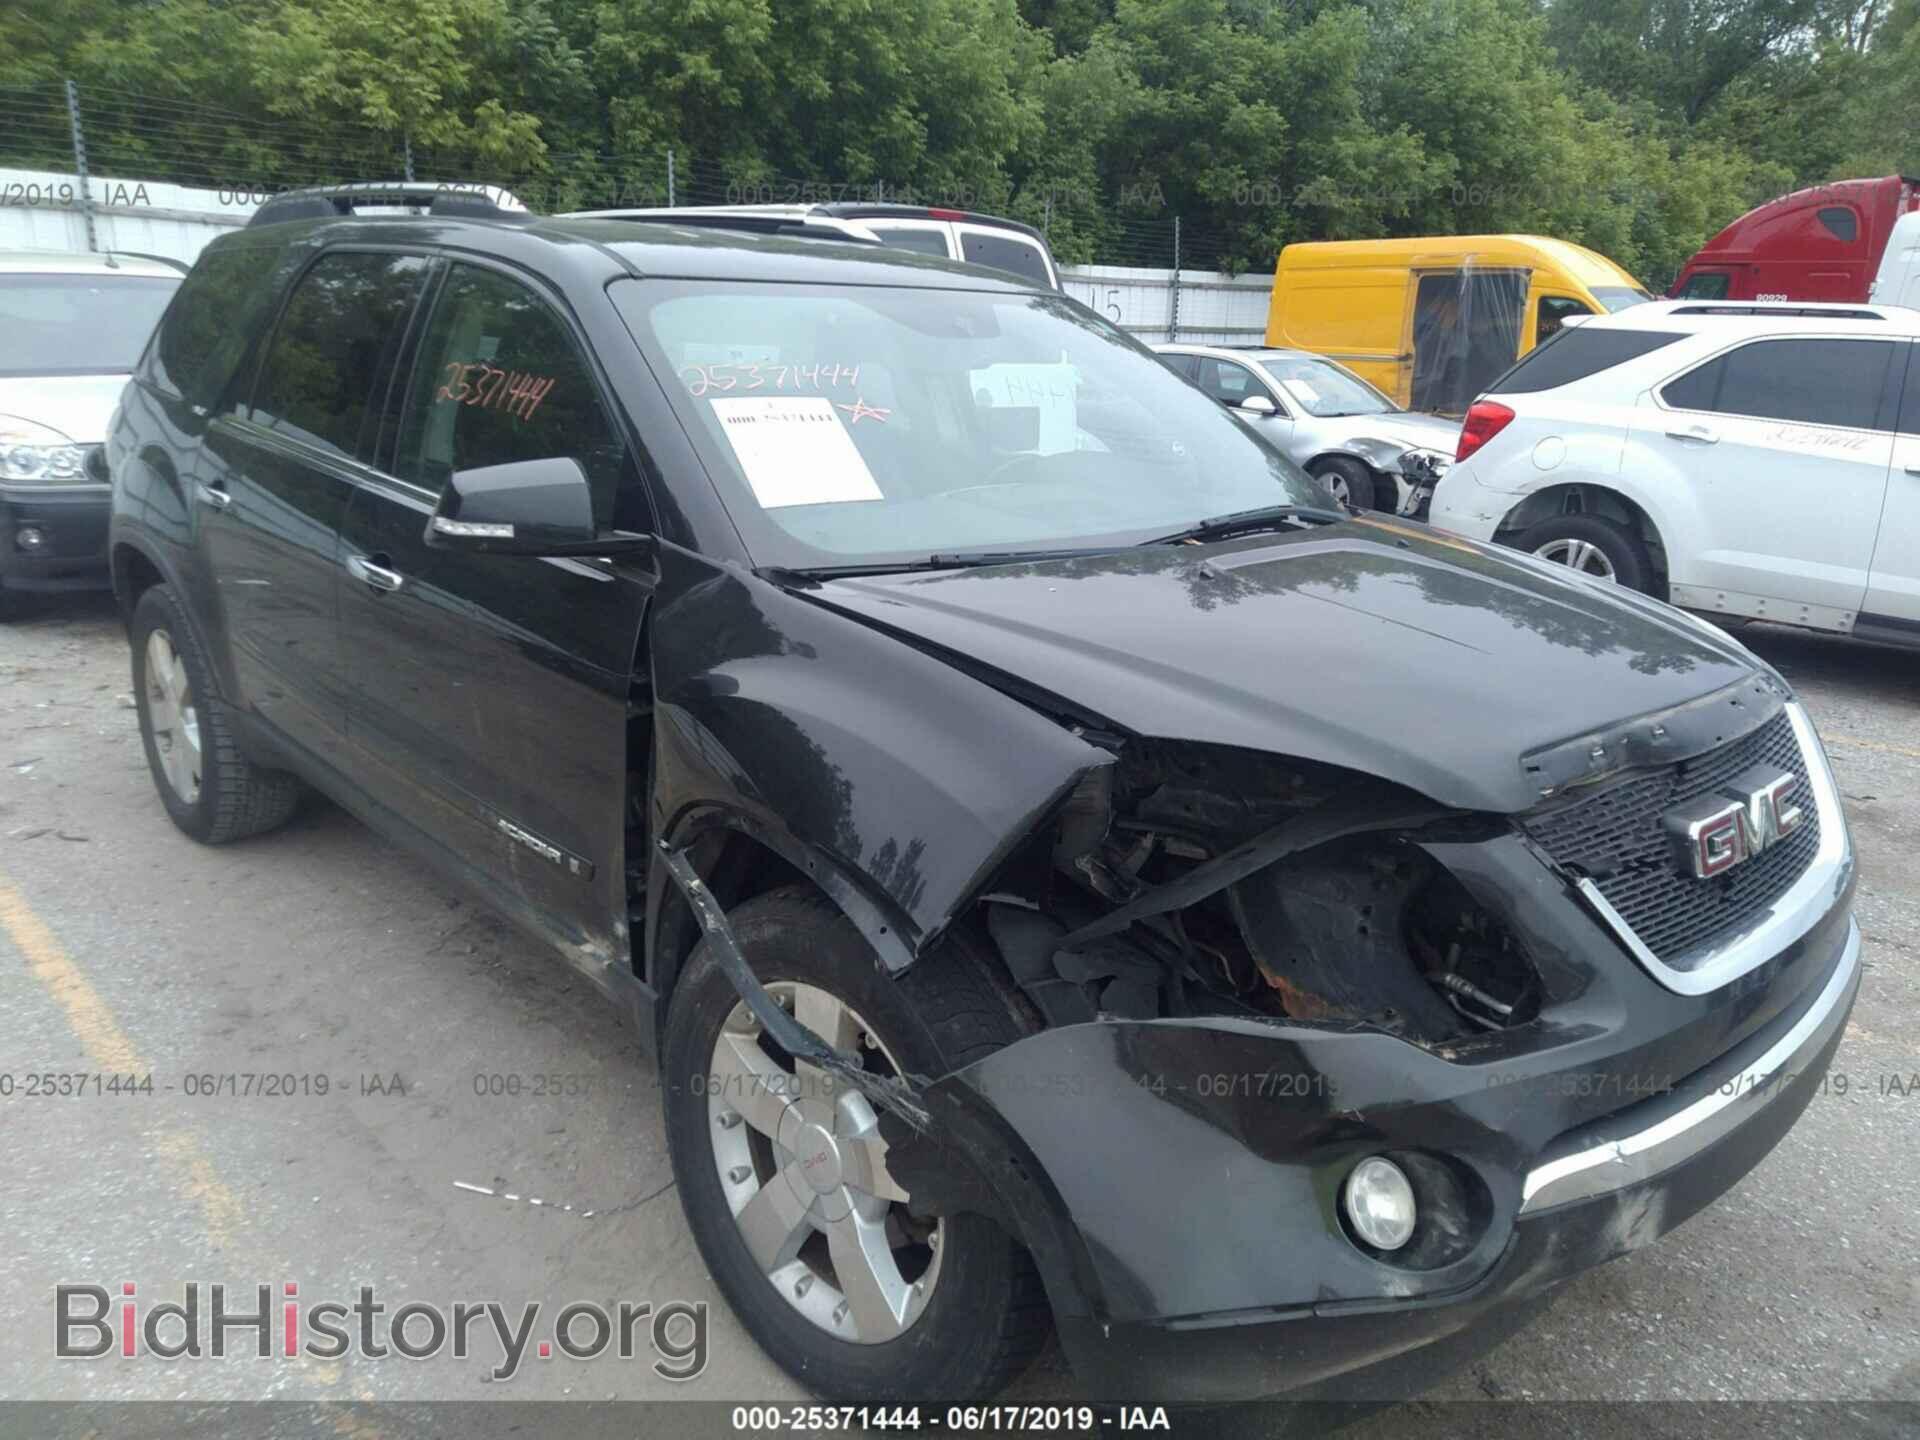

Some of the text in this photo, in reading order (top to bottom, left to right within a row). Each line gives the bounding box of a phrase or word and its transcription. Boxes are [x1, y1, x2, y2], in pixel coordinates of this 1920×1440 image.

[436, 362, 555, 422] 25371444
[679, 363, 861, 396] 25371444
[1689, 772, 1801, 879] GMC
